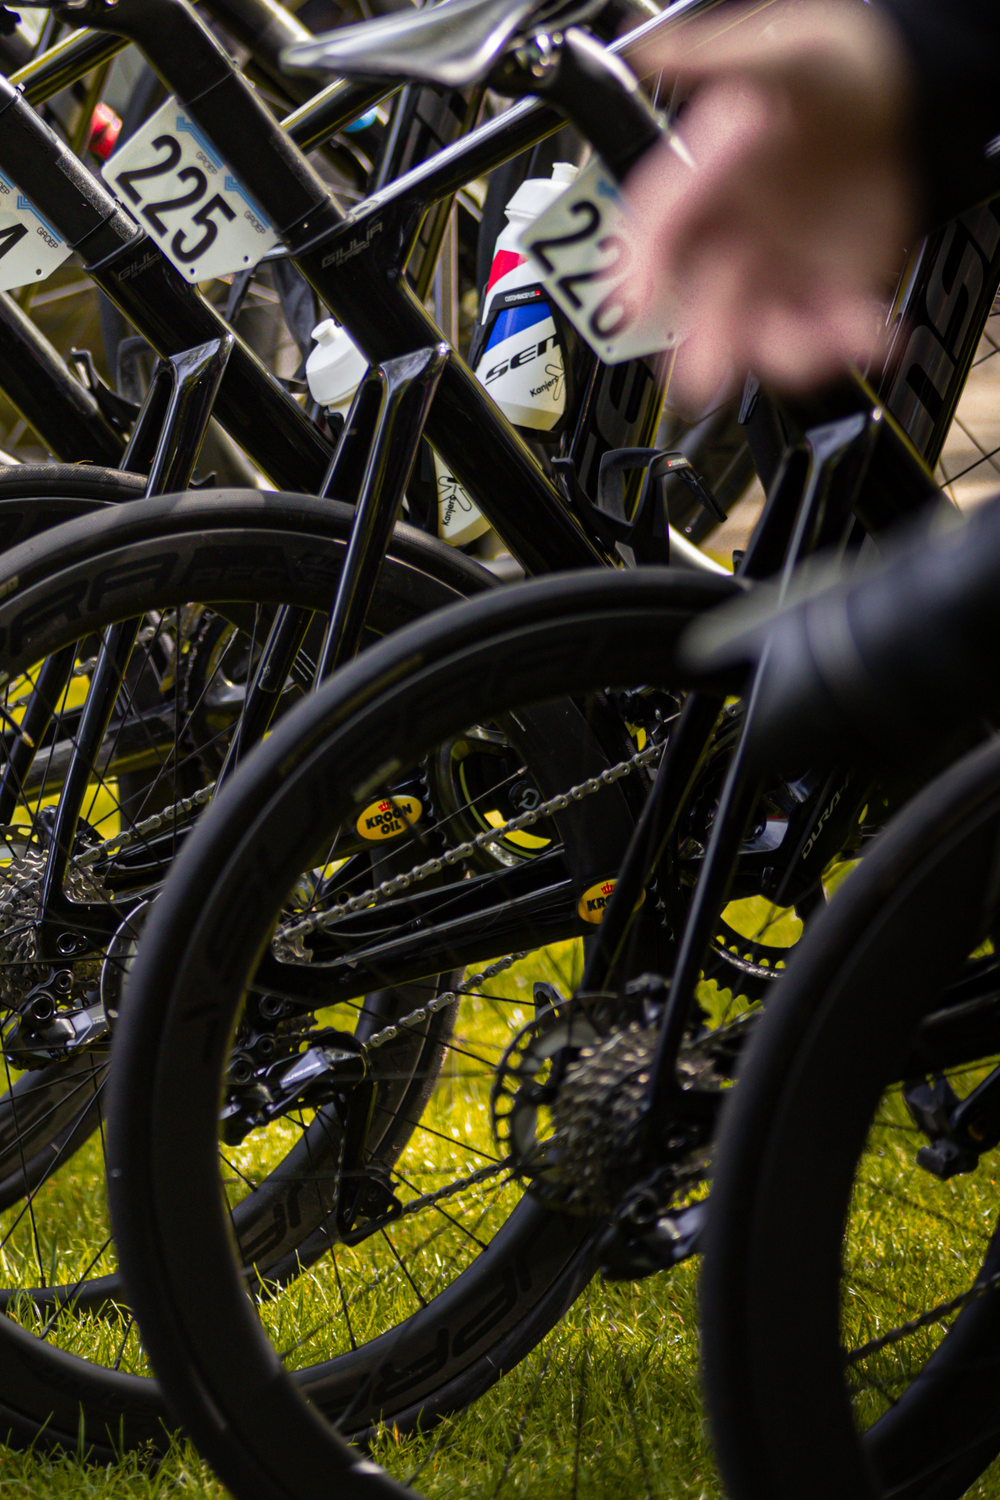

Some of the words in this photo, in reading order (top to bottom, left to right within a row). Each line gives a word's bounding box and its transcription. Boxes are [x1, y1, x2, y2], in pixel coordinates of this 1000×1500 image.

[195, 150, 219, 176] GROEP
[114, 134, 238, 265] 225
[243, 210, 267, 235] GROEP
[36, 226, 60, 250] GROEP
[321, 221, 384, 269] GIULIA
[117, 252, 163, 283] GIUL
[529, 375, 560, 398] Kanjers
[441, 492, 457, 527] Kanjers
[365, 803, 413, 831] KROON
[381, 820, 402, 835] OIL
